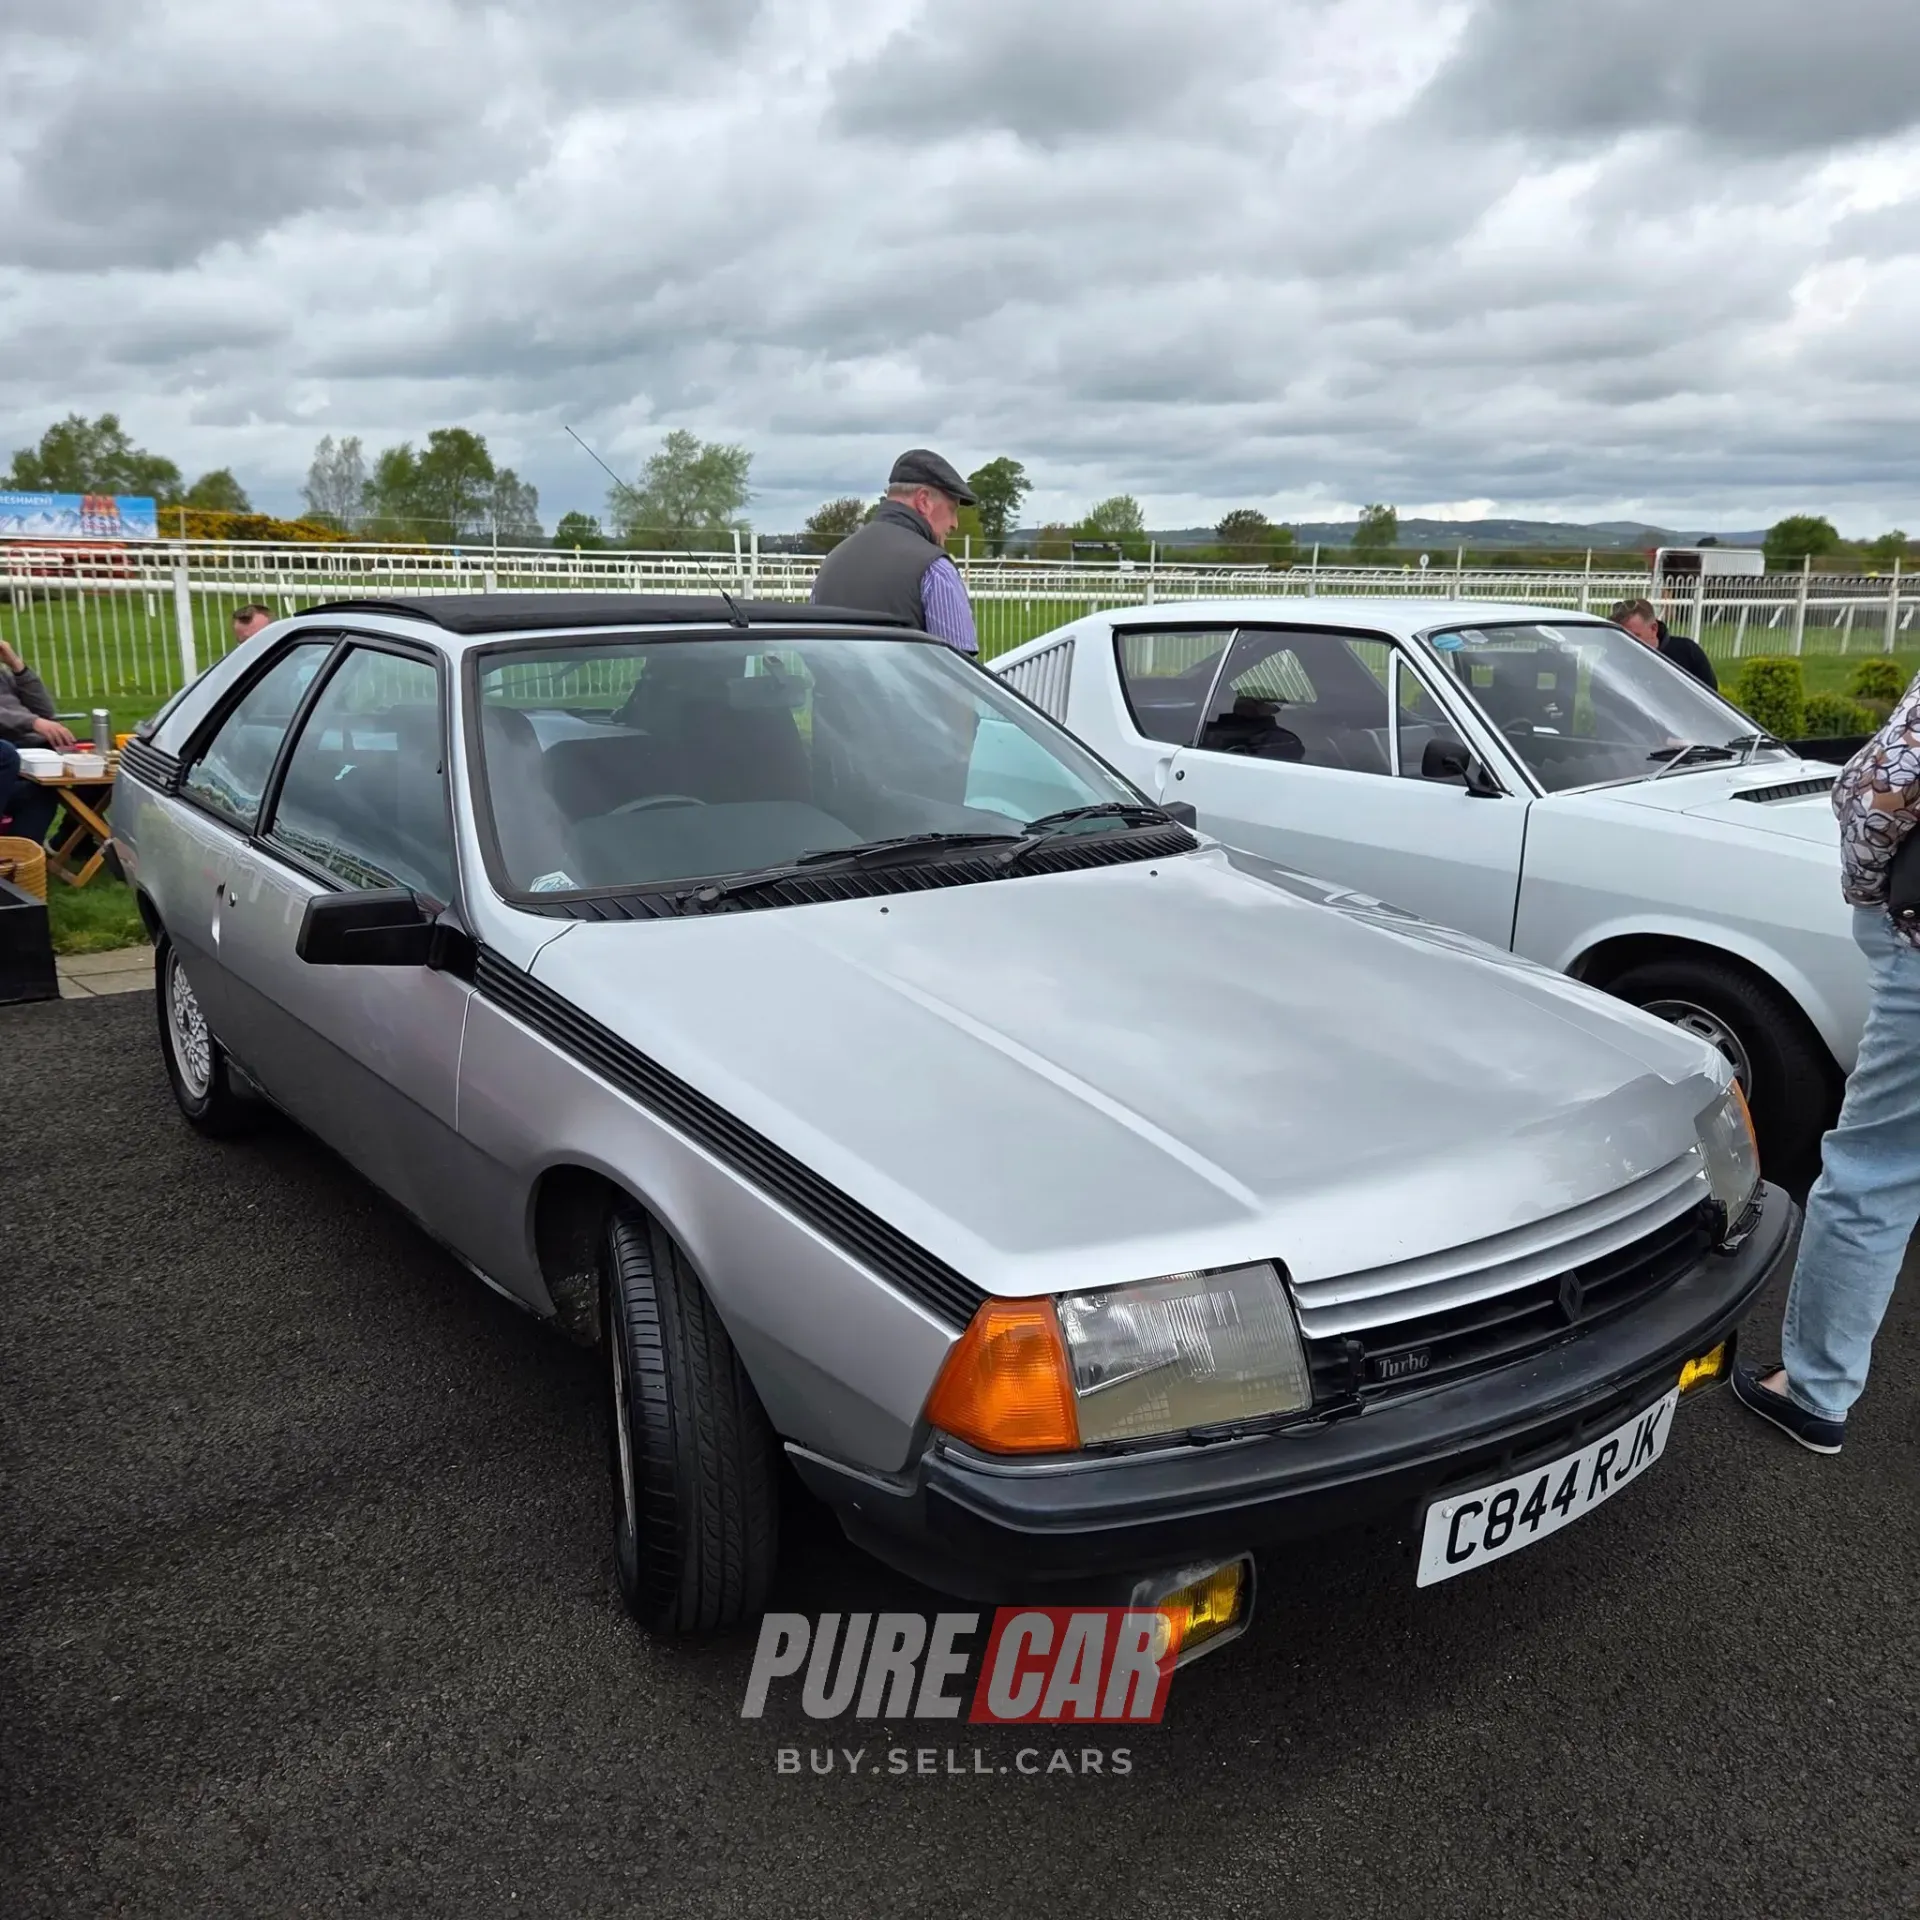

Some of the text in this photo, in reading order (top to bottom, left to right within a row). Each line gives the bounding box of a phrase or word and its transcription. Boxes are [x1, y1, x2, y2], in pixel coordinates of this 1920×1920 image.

[1380, 1353, 1429, 1378] Turbo
[1446, 1403, 1666, 1564] C844 RJK
